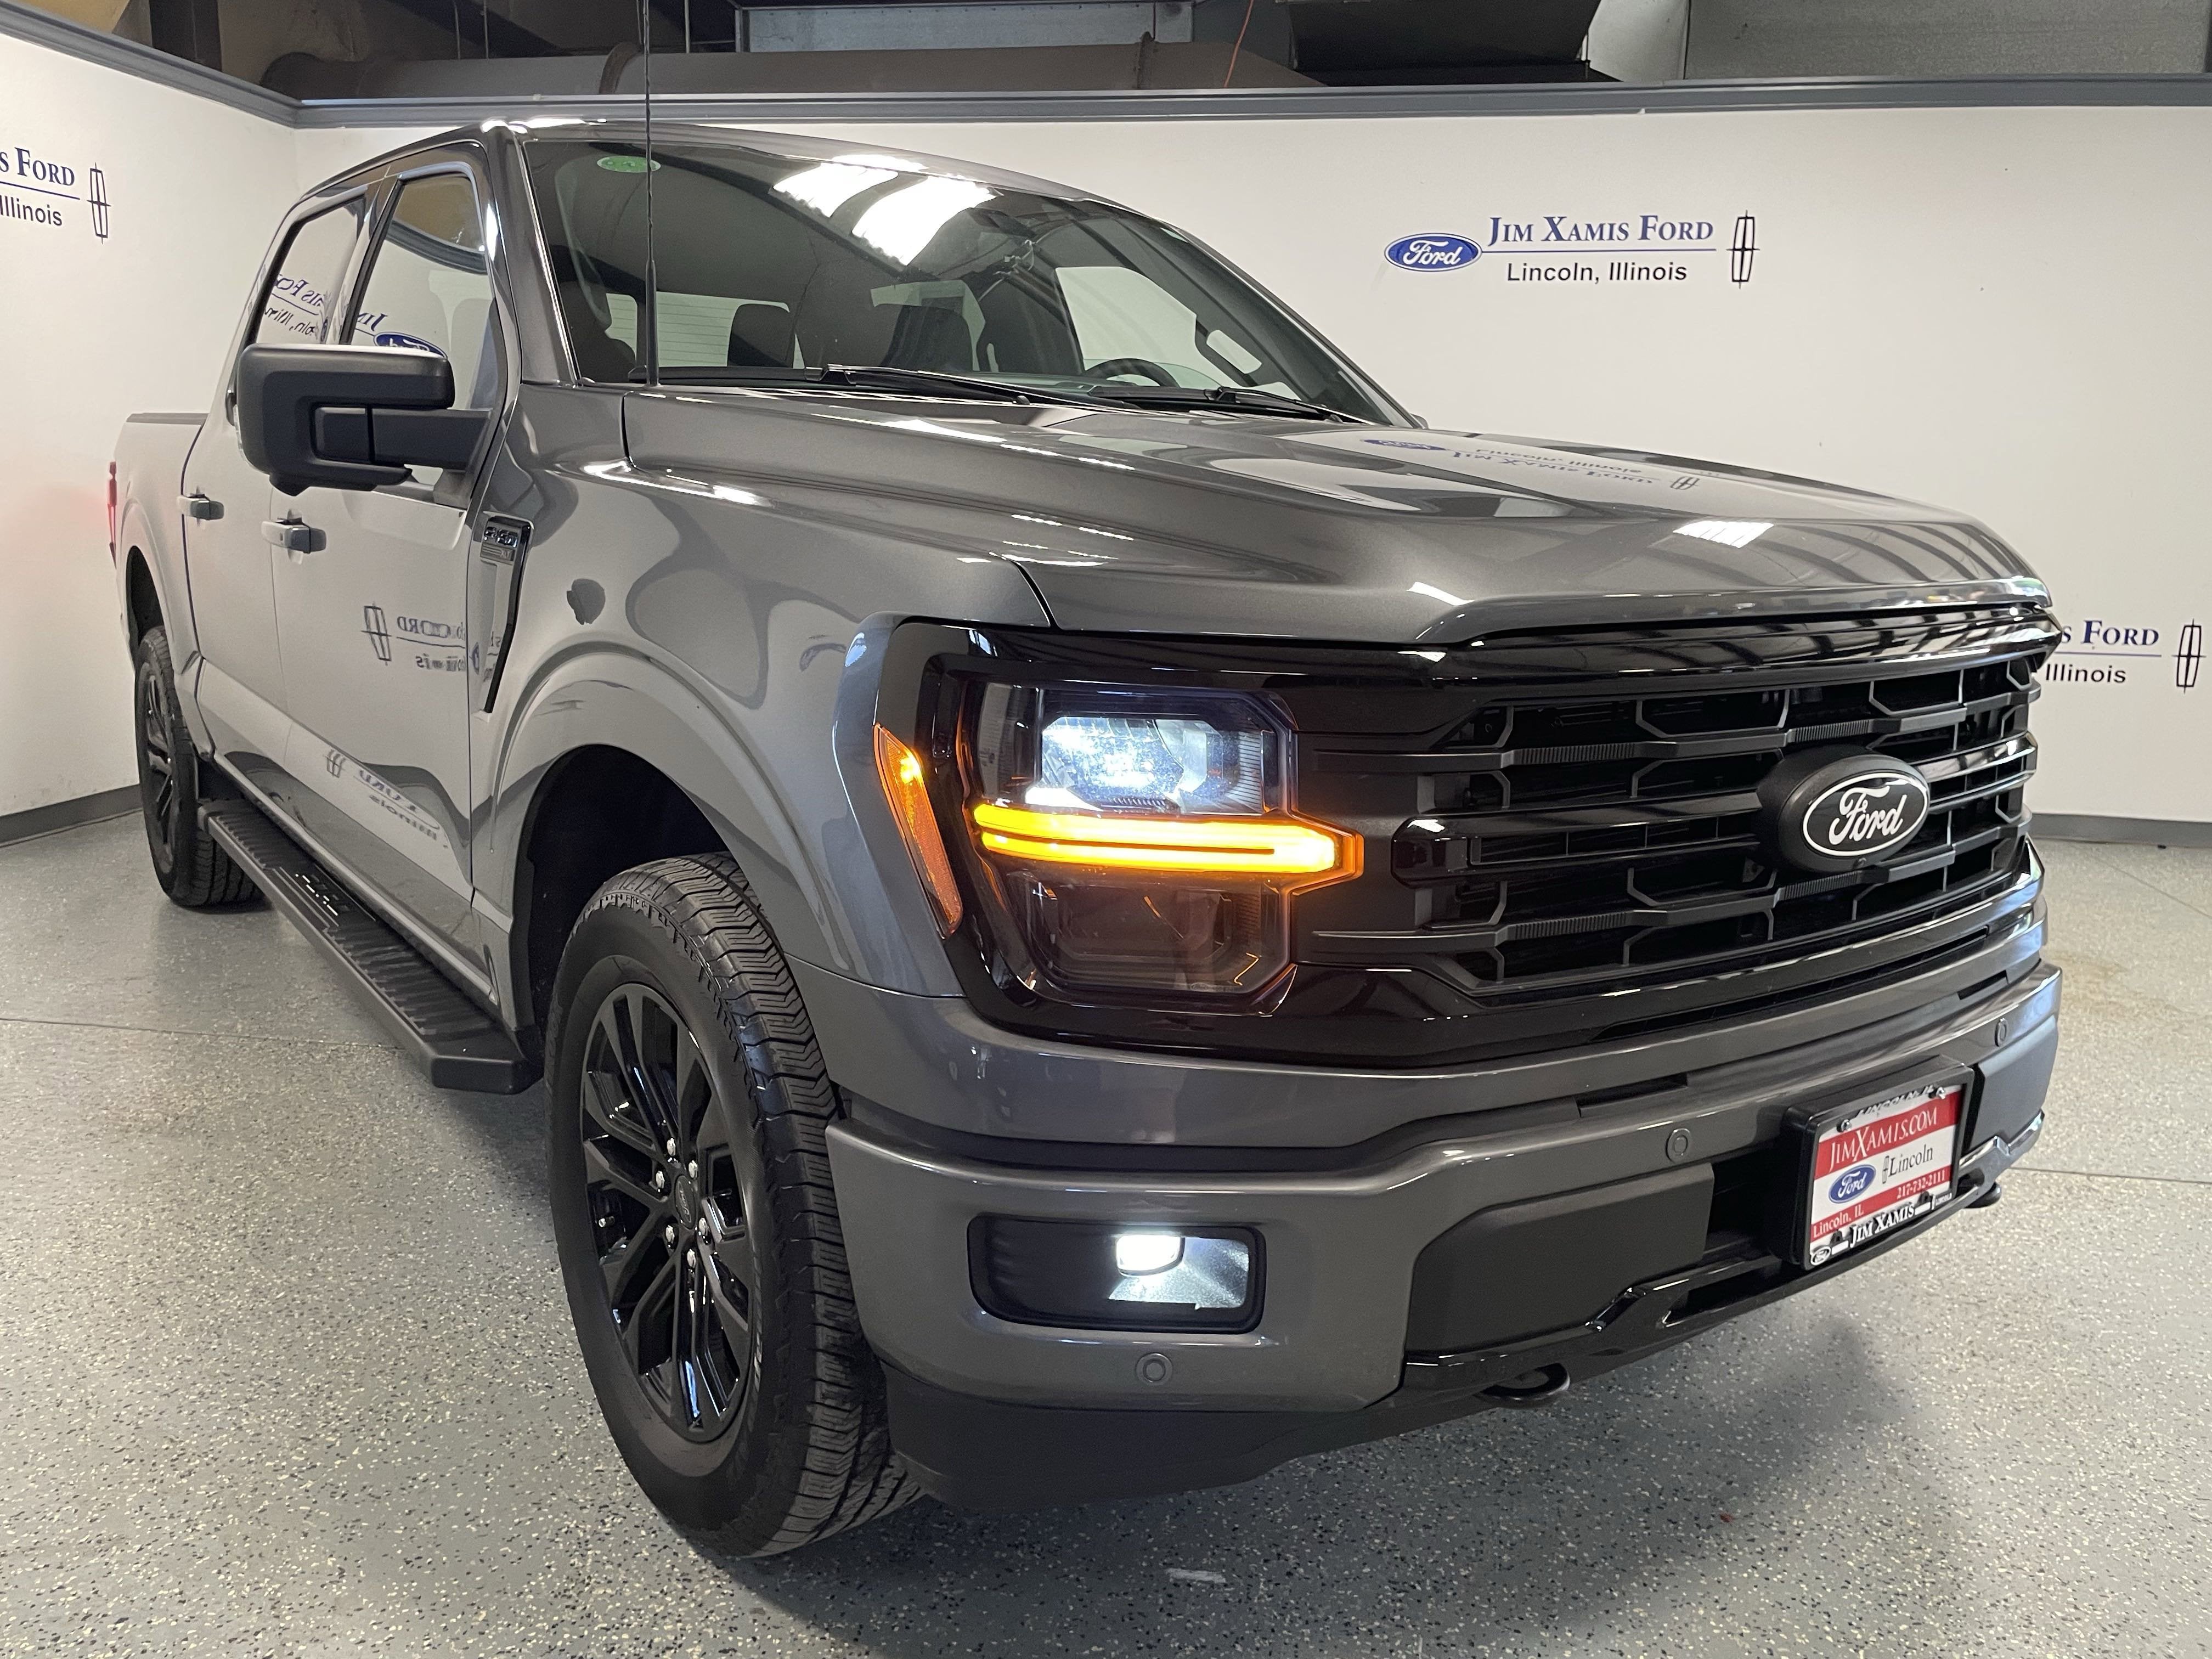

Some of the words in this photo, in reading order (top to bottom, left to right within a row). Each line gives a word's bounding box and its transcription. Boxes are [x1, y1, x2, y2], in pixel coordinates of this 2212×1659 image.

[14, 146, 75, 186] FORD
[1487, 217, 1534, 247] JIM
[1540, 216, 1630, 241] XAMIS
[1637, 215, 1713, 240] FORD
[1402, 240, 1463, 264] Ford
[1508, 262, 1600, 284] Lincoln,
[1609, 262, 1687, 281] Illinois
[2080, 619, 2159, 646] FORD
[2045, 663, 2126, 684] Illinois
[1829, 786, 1908, 845] Ford
[1829, 1106, 1937, 1173] JIMXAMIS.COM
[1888, 1143, 1934, 1178] Lincoln
[1837, 1170, 1867, 1199] Ford
[1896, 1169, 1945, 1200] 217-732-2111
[1849, 1222, 1874, 1249] JIM
[1874, 1204, 1915, 1234] XAMIS
[1854, 1204, 1865, 1218] IL
